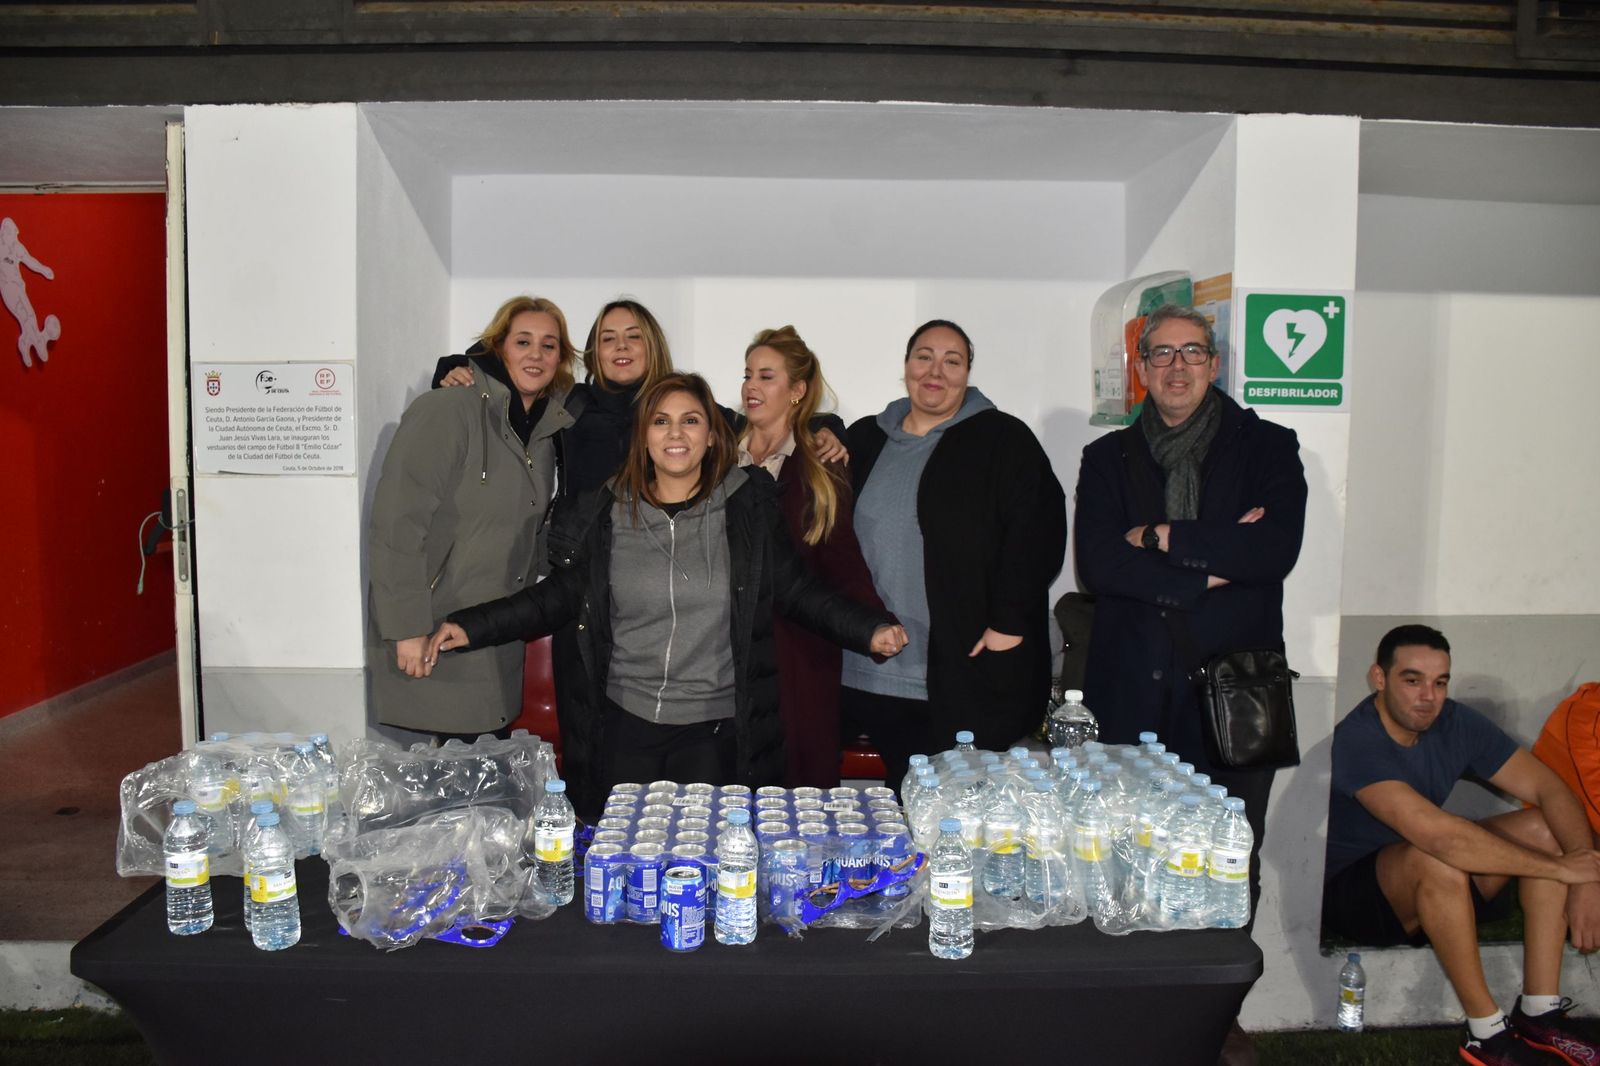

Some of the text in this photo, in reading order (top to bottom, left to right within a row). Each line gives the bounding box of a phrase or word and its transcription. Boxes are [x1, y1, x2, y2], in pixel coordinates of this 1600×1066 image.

[1248, 387, 1338, 398] DESFIBRILADOR
[315, 405, 333, 413] Fútbol
[275, 452, 293, 460] Fútbol
